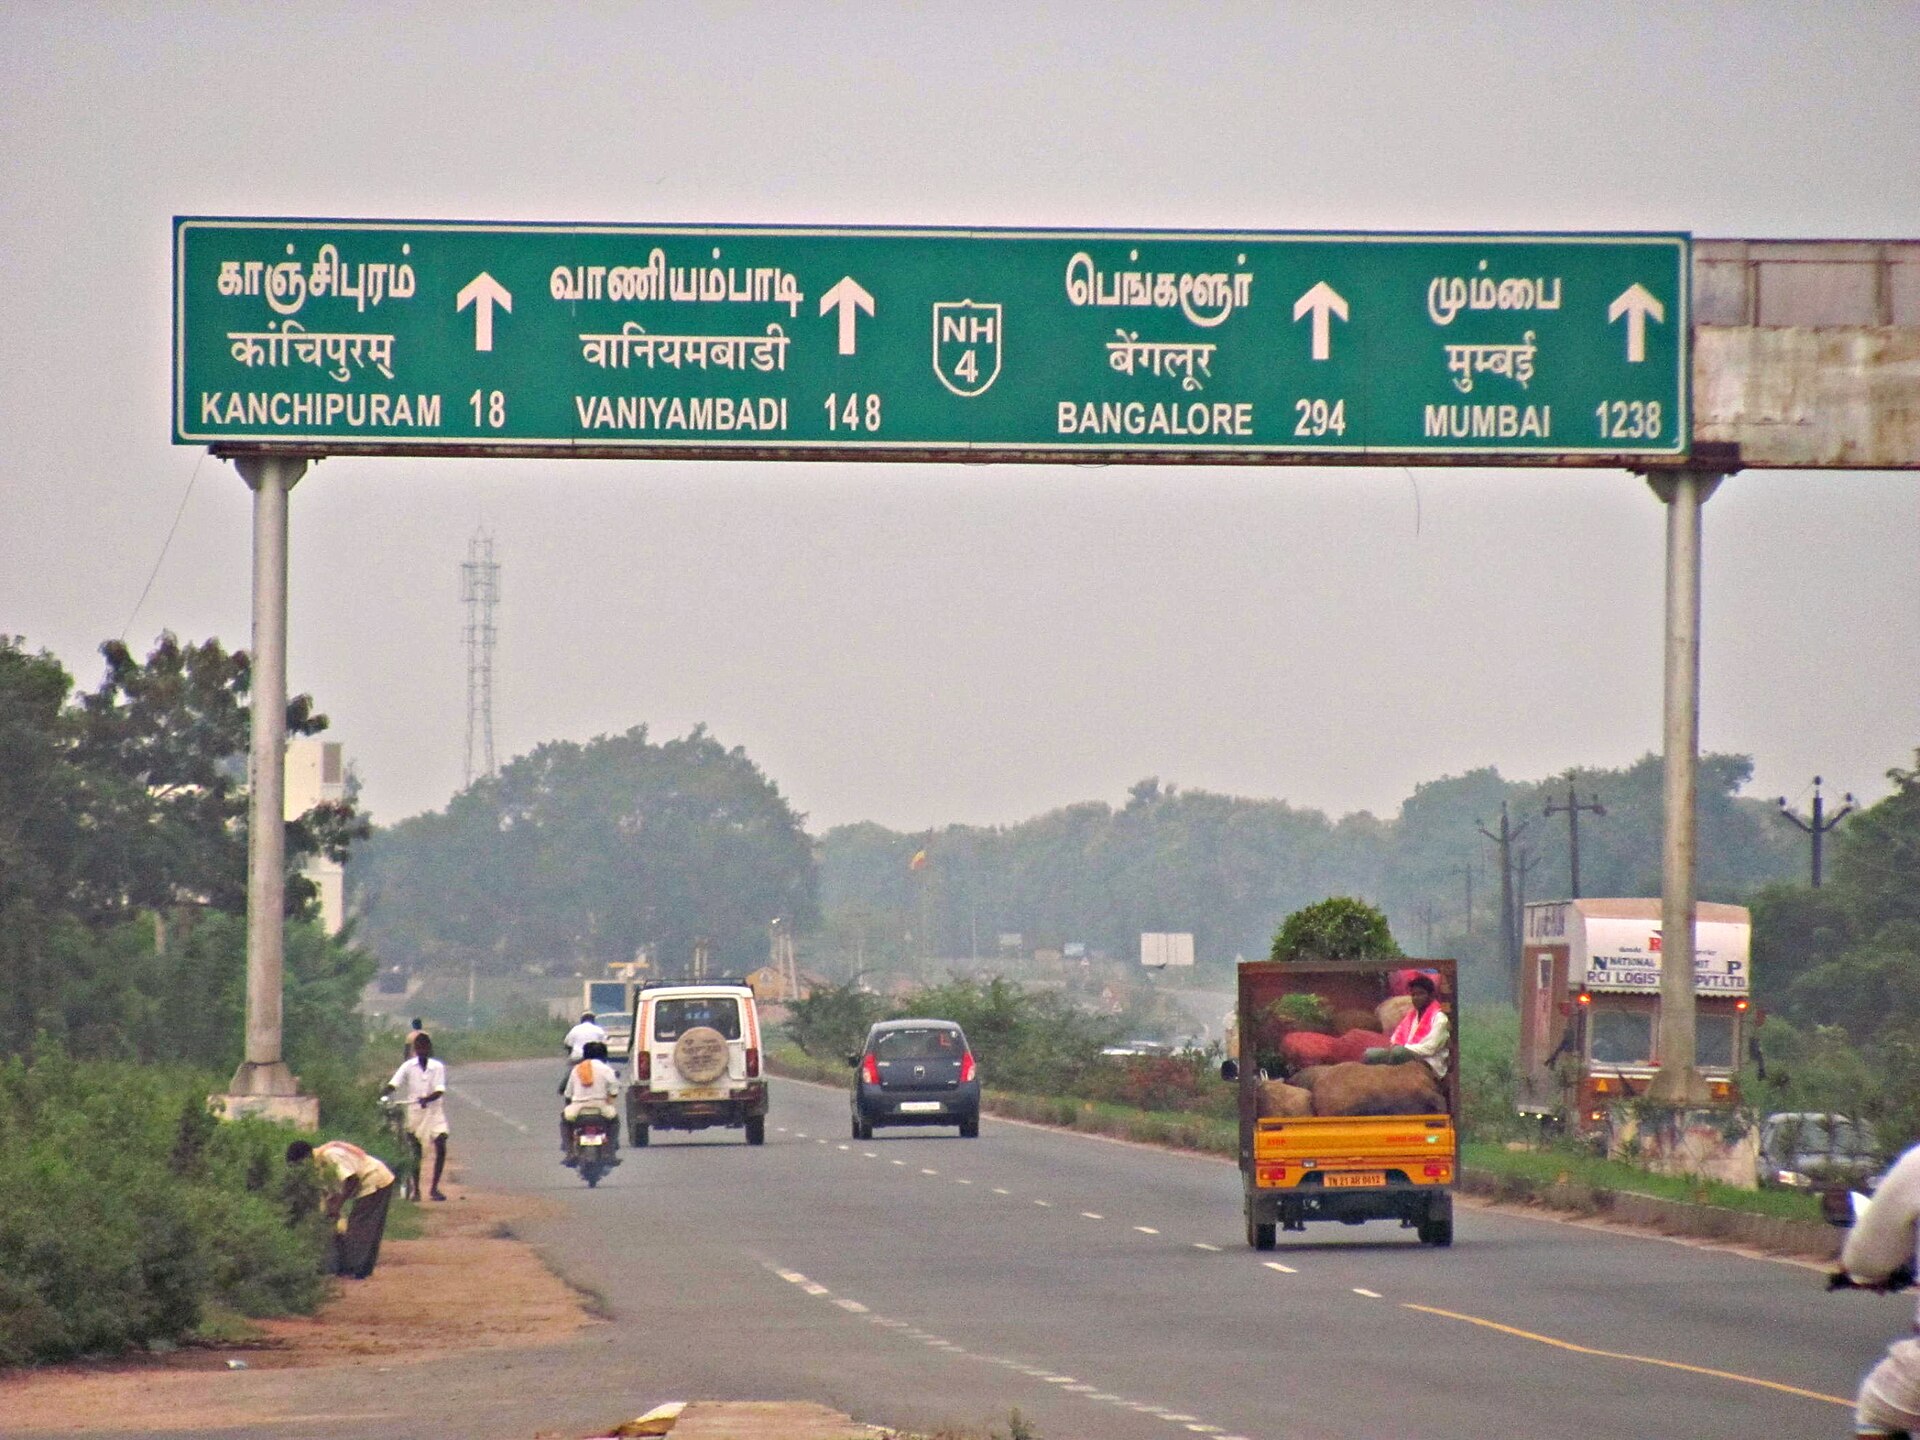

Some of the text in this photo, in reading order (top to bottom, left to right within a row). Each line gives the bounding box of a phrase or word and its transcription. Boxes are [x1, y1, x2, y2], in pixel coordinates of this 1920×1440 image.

[218, 243, 416, 315] காஞ்சிபுரம்
[550, 247, 804, 317] வாணியம்பாடி
[1066, 249, 1253, 327] பெங்களூர்
[1428, 259, 1561, 325] மும்பை
[227, 320, 395, 382] कांचिपुरम्
[579, 321, 791, 372] वानियमबाडी
[942, 316, 994, 343] NH
[954, 350, 978, 383] 4
[1106, 328, 1217, 391] बेंगलूर
[1445, 330, 1537, 393] मुम्बई
[201, 389, 505, 428] KANCHIPURAM 18
[575, 393, 881, 432] VANIYAMBADI 148
[1058, 399, 1346, 437] BANGALORE 294
[1425, 401, 1661, 439] MUMBAI 1238
[1587, 971, 1610, 982] RCI
[1616, 972, 1662, 984] LOGIS
[1727, 960, 1742, 975] P
